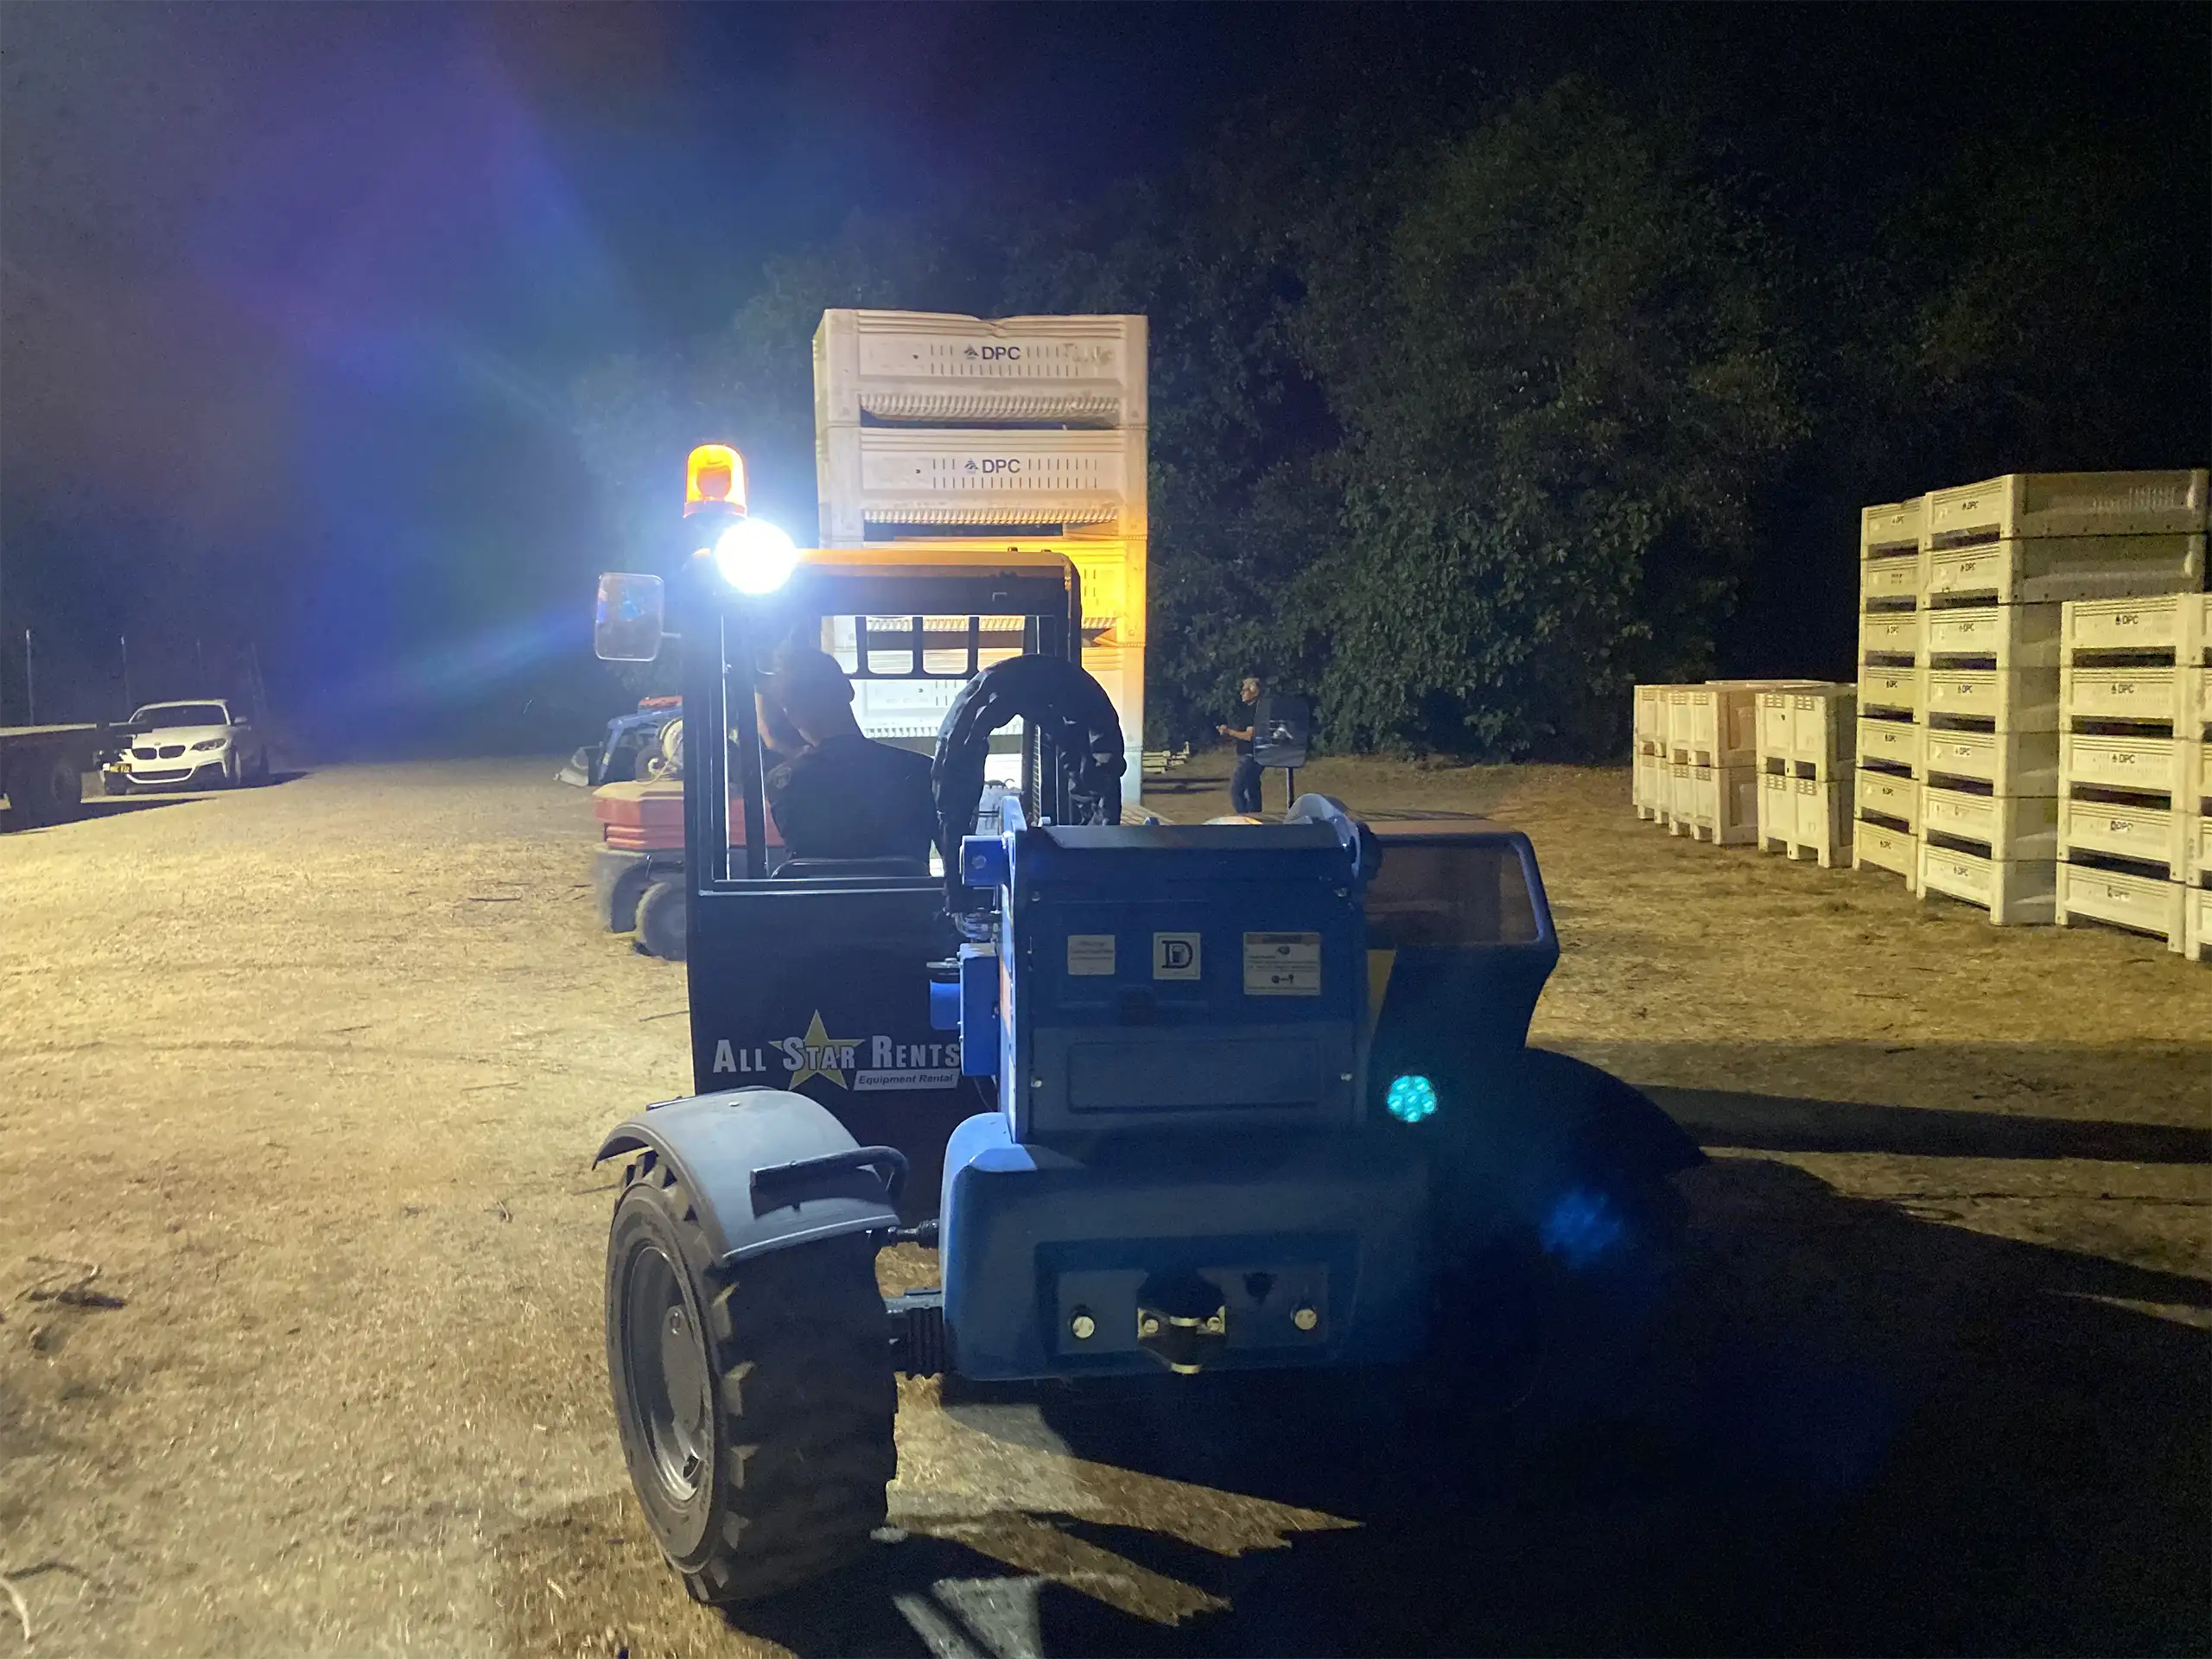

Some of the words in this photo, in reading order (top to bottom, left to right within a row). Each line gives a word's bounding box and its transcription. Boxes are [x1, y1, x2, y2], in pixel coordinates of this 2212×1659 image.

[982, 346, 1021, 360] DPC
[982, 459, 1021, 474] DPC
[2121, 615, 2139, 625] DPC
[1962, 623, 1974, 632] DPC
[2118, 684, 2135, 694] DPC
[2119, 754, 2135, 764] DPC
[1958, 868, 1968, 876] DPC
[858, 1074, 916, 1085] Equipment
[918, 1073, 953, 1083] Rental
